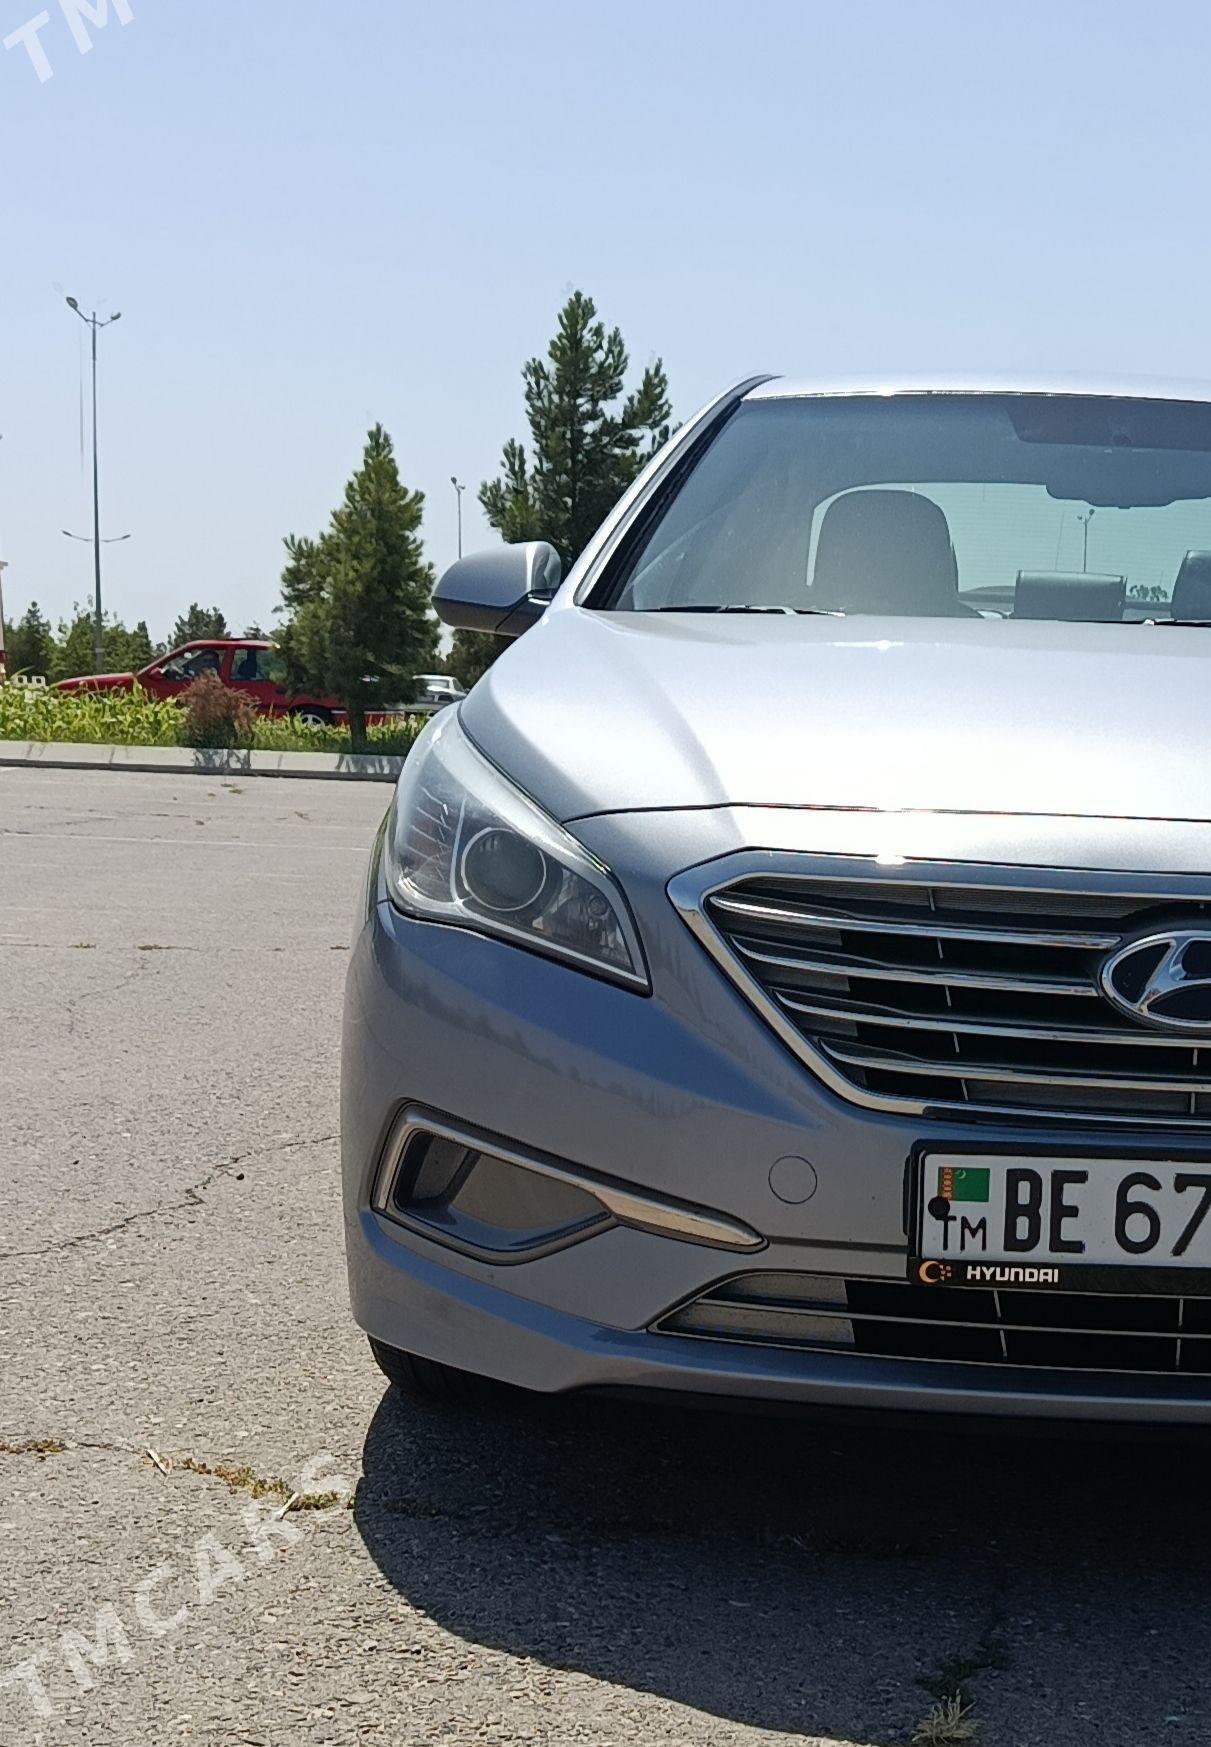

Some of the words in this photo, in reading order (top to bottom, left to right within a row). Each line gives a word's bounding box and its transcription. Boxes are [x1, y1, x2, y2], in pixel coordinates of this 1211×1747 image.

[934, 1215, 987, 1251] TM
[1003, 1168, 1088, 1253] BE
[966, 1266, 1059, 1283] HYUNDAI
